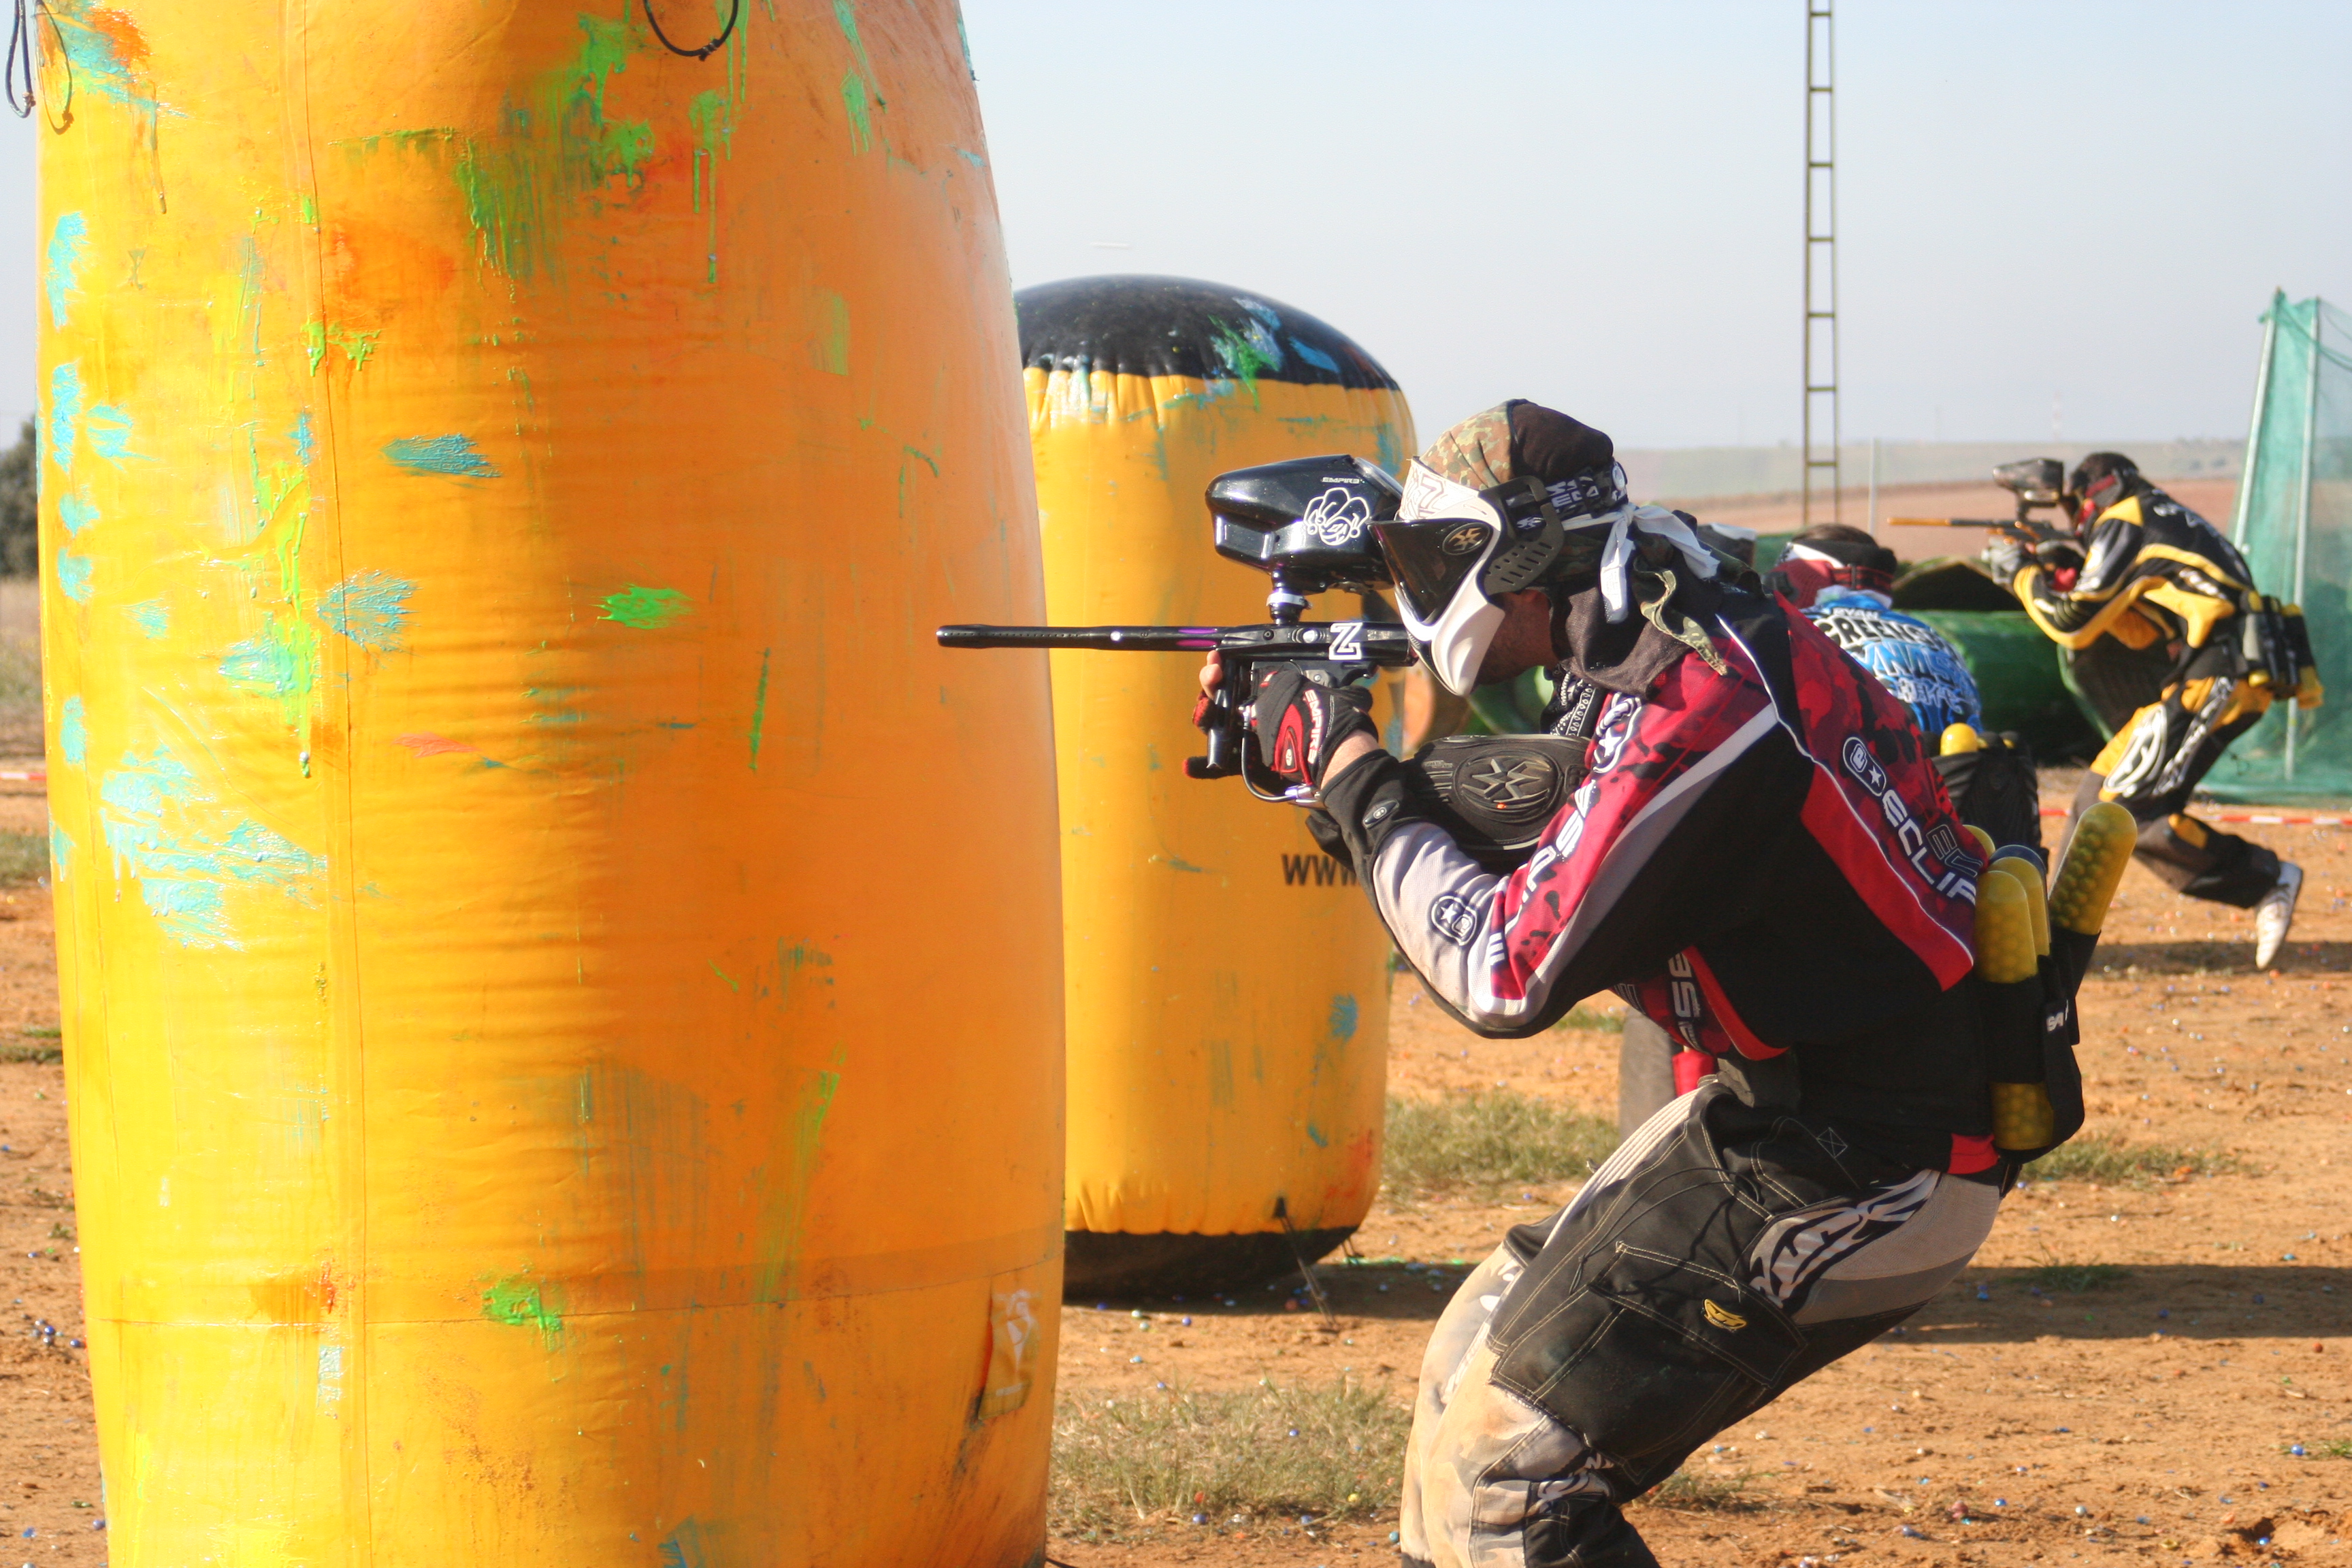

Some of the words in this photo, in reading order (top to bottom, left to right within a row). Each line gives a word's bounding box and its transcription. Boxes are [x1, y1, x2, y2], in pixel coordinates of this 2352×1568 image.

[1321, 476, 1360, 485] EMPIRE
[1328, 622, 1364, 660] Z
[1303, 689, 1322, 765] EMPIRE
[1882, 789, 1977, 906] ECLIP
